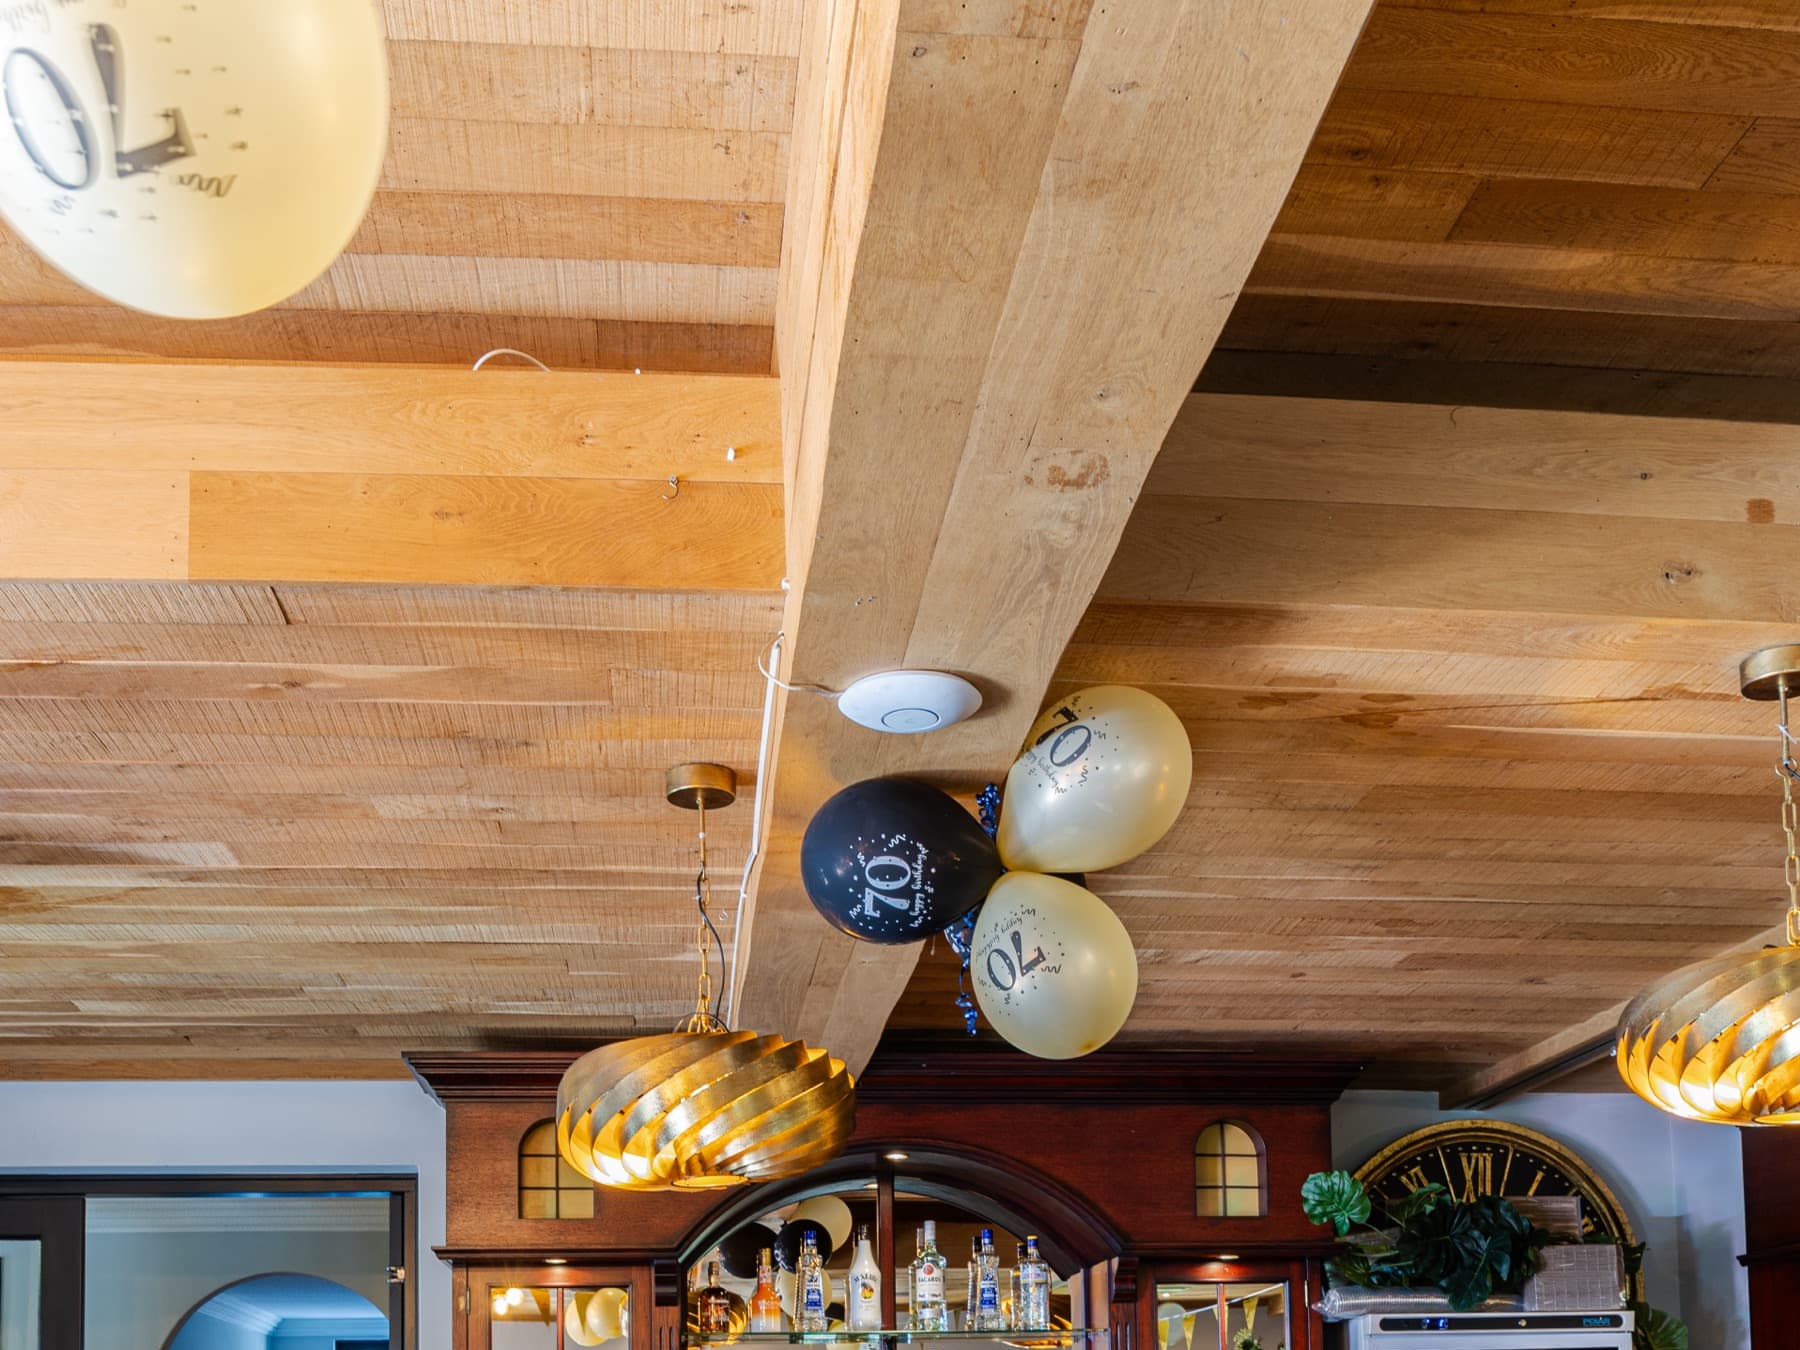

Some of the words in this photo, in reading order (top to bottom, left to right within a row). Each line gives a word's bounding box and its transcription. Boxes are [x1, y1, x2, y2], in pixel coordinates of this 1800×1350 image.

[2, 22, 197, 191] 70
[1036, 706, 1092, 768] 70
[864, 855, 912, 918] 70
[911, 854, 927, 890] birthday
[909, 893, 925, 916] happy
[987, 930, 1046, 991] 70
[1459, 1152, 1494, 1204] XII
